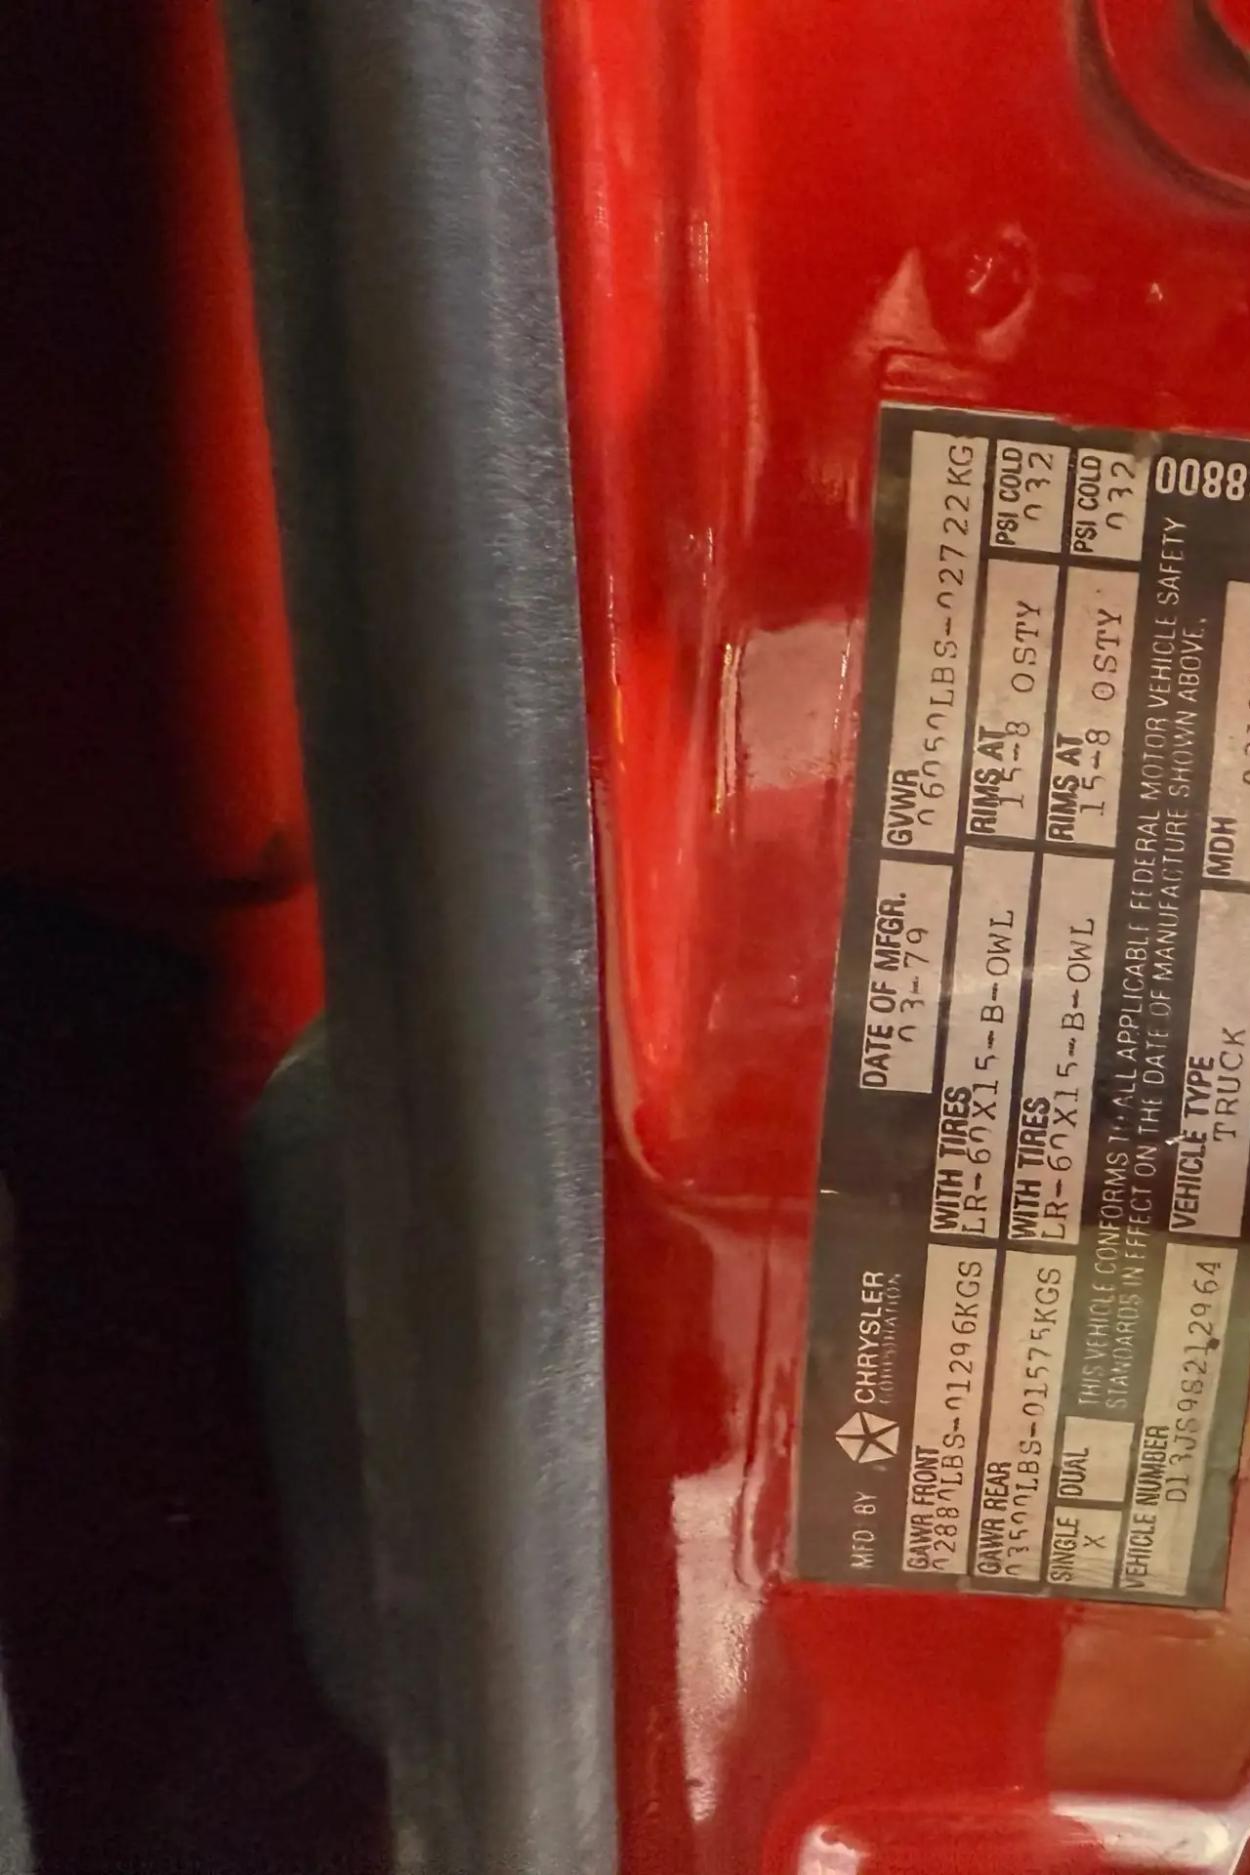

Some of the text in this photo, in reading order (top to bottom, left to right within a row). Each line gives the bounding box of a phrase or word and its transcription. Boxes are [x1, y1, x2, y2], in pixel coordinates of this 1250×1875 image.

[994, 445, 1024, 546] PSI COLD
[1073, 453, 1103, 554] PSI COLD
[969, 724, 1005, 834] RIMS AT
[1047, 731, 1083, 841] RIMS AT
[1167, 709, 1198, 798] SHOWN
[886, 766, 919, 847] GVWR
[1205, 814, 1237, 877] MDH
[1151, 807, 1189, 981] MANUFACTURE
[861, 889, 906, 1088] DATE OF MFGR.
[1078, 515, 1188, 1405] THIS VEHICLE CONFORMS T ALL APPLICABLE FEDERAL MOTOR VEHICLE SAFETY
[1148, 989, 1172, 1016] OF
[1141, 1028, 1169, 1084] DATE
[1210, 1026, 1247, 1143] TRUCK
[932, 1084, 971, 1231] WITH TIRES
[1133, 1143, 1158, 1177] ON
[1137, 1096, 1162, 1135] THE
[1171, 1054, 1215, 1230] VEHICLE TYPE
[1010, 1094, 1051, 1240] WITH TIRES
[1124, 1185, 1153, 1259] EFFECT
[1120, 1264, 1143, 1286] IN
[853, 1269, 886, 1403] CHRYSLER
[1106, 1291, 1143, 1410] STANDARDS
[905, 1444, 940, 1570] GAWR FRONT
[977, 1459, 1012, 1575] GAWR REAR
[1059, 1445, 1089, 1497] DUAL
[1125, 1423, 1170, 1591] VEHICLE NUMBER
[850, 1489, 878, 1570] MFD BY
[1050, 1516, 1080, 1583] SINGLE
[1082, 1534, 1107, 1549] X
